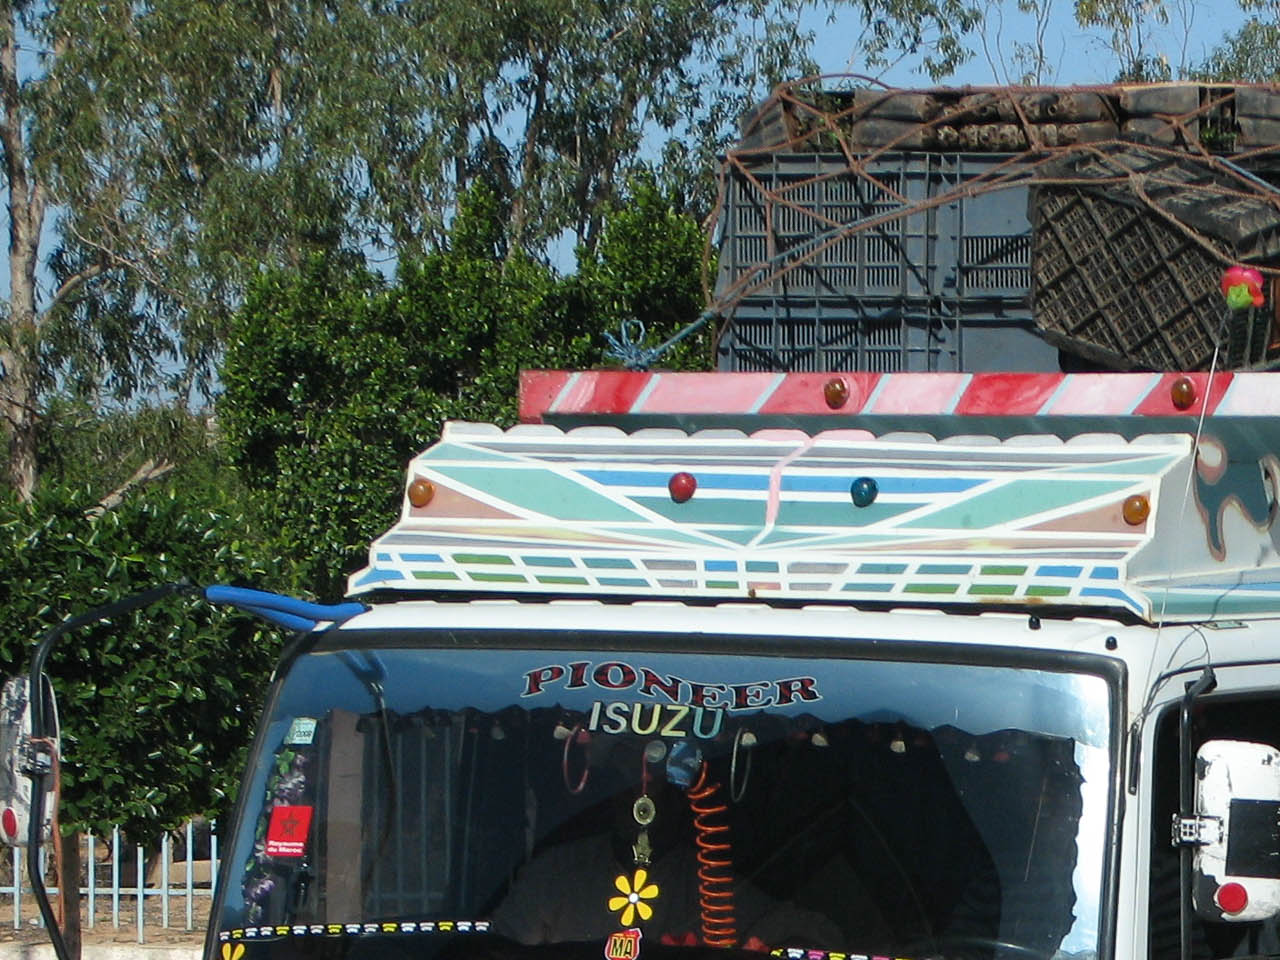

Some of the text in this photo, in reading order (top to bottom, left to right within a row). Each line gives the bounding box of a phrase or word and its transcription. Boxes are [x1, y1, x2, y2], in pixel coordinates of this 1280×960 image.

[520, 659, 823, 712] PIONEER
[588, 700, 727, 740] ISUZU
[610, 937, 632, 957] MA
